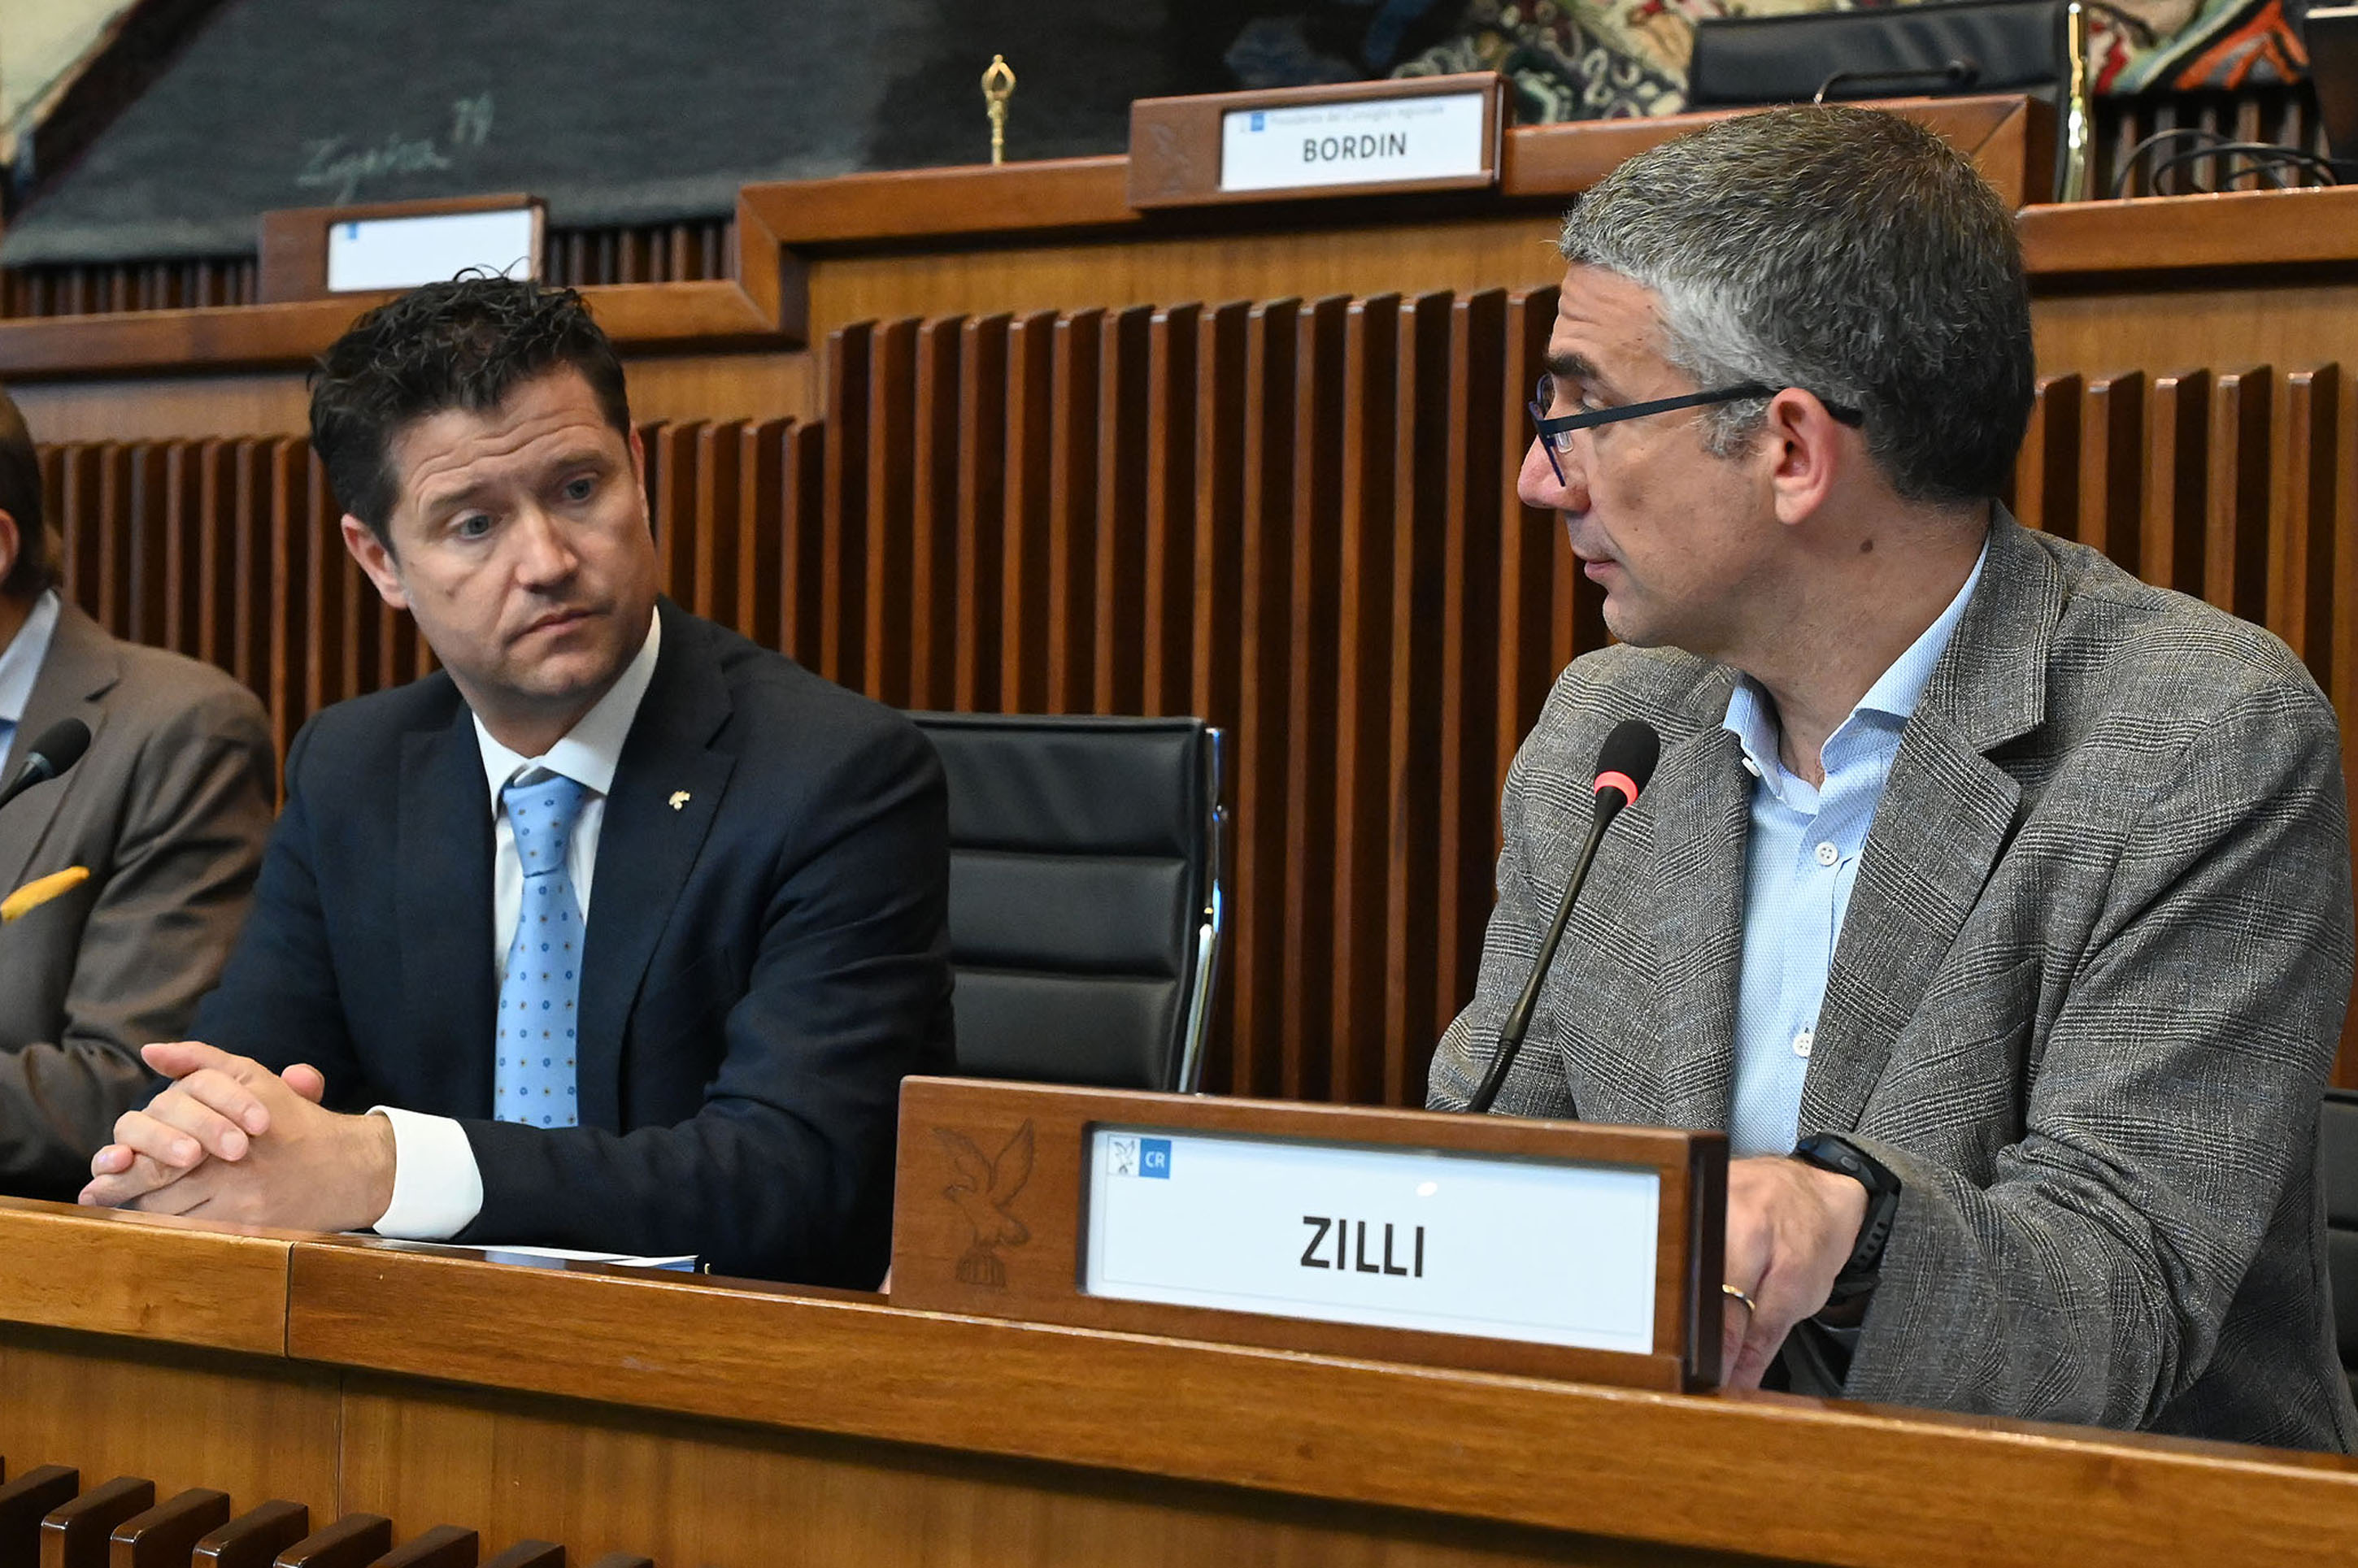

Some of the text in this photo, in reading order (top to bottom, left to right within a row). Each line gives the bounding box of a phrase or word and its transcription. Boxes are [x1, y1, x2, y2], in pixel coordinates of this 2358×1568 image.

[1303, 132, 1406, 162] BORDIN
[1145, 1151, 1165, 1168] CR
[1301, 1216, 1424, 1278] ZILLI
